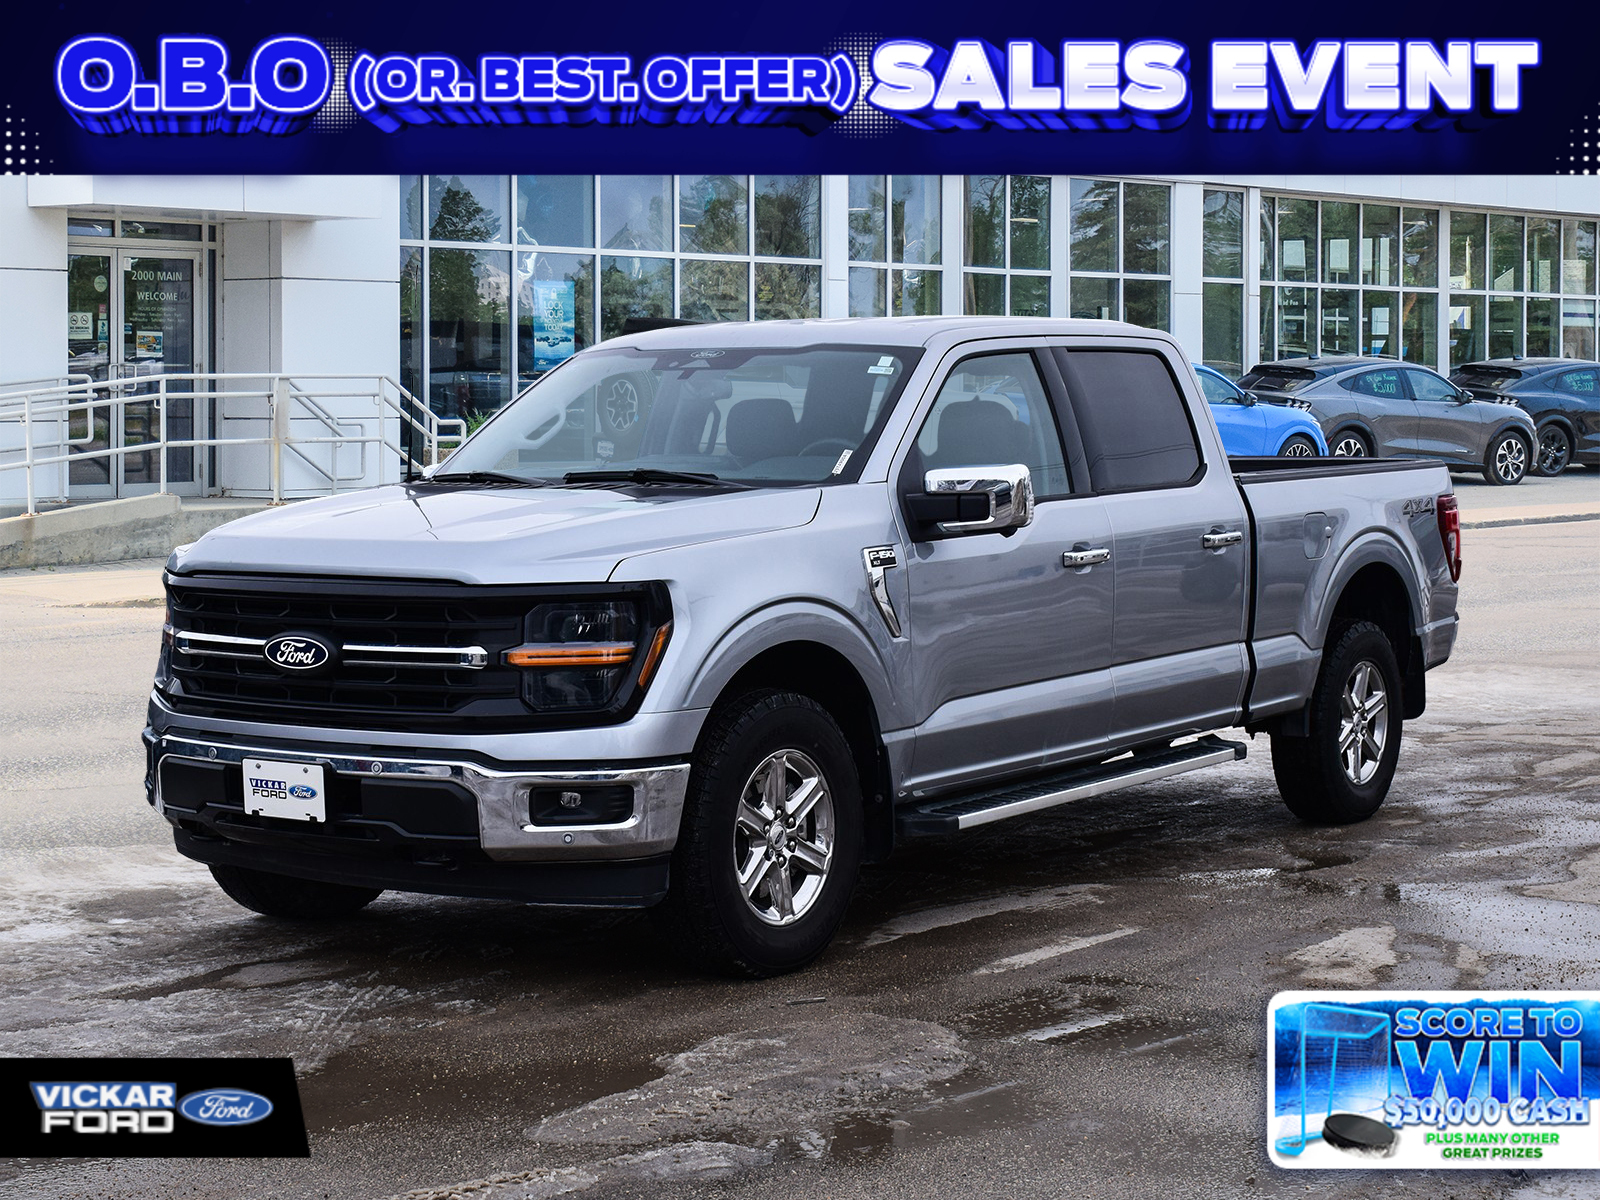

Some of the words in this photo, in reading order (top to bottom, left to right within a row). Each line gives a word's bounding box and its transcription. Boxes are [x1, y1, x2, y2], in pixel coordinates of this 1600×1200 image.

[131, 270, 155, 281] 2000
[157, 271, 183, 281] MAIN
[136, 291, 178, 301] WELCOME
[543, 300, 564, 310] LOCK
[543, 309, 564, 319] YOUR
[869, 550, 895, 560] F-150
[276, 640, 316, 664] Ford
[250, 778, 287, 791] VICKAR
[252, 788, 287, 800] FORD
[293, 786, 313, 798] Ford
